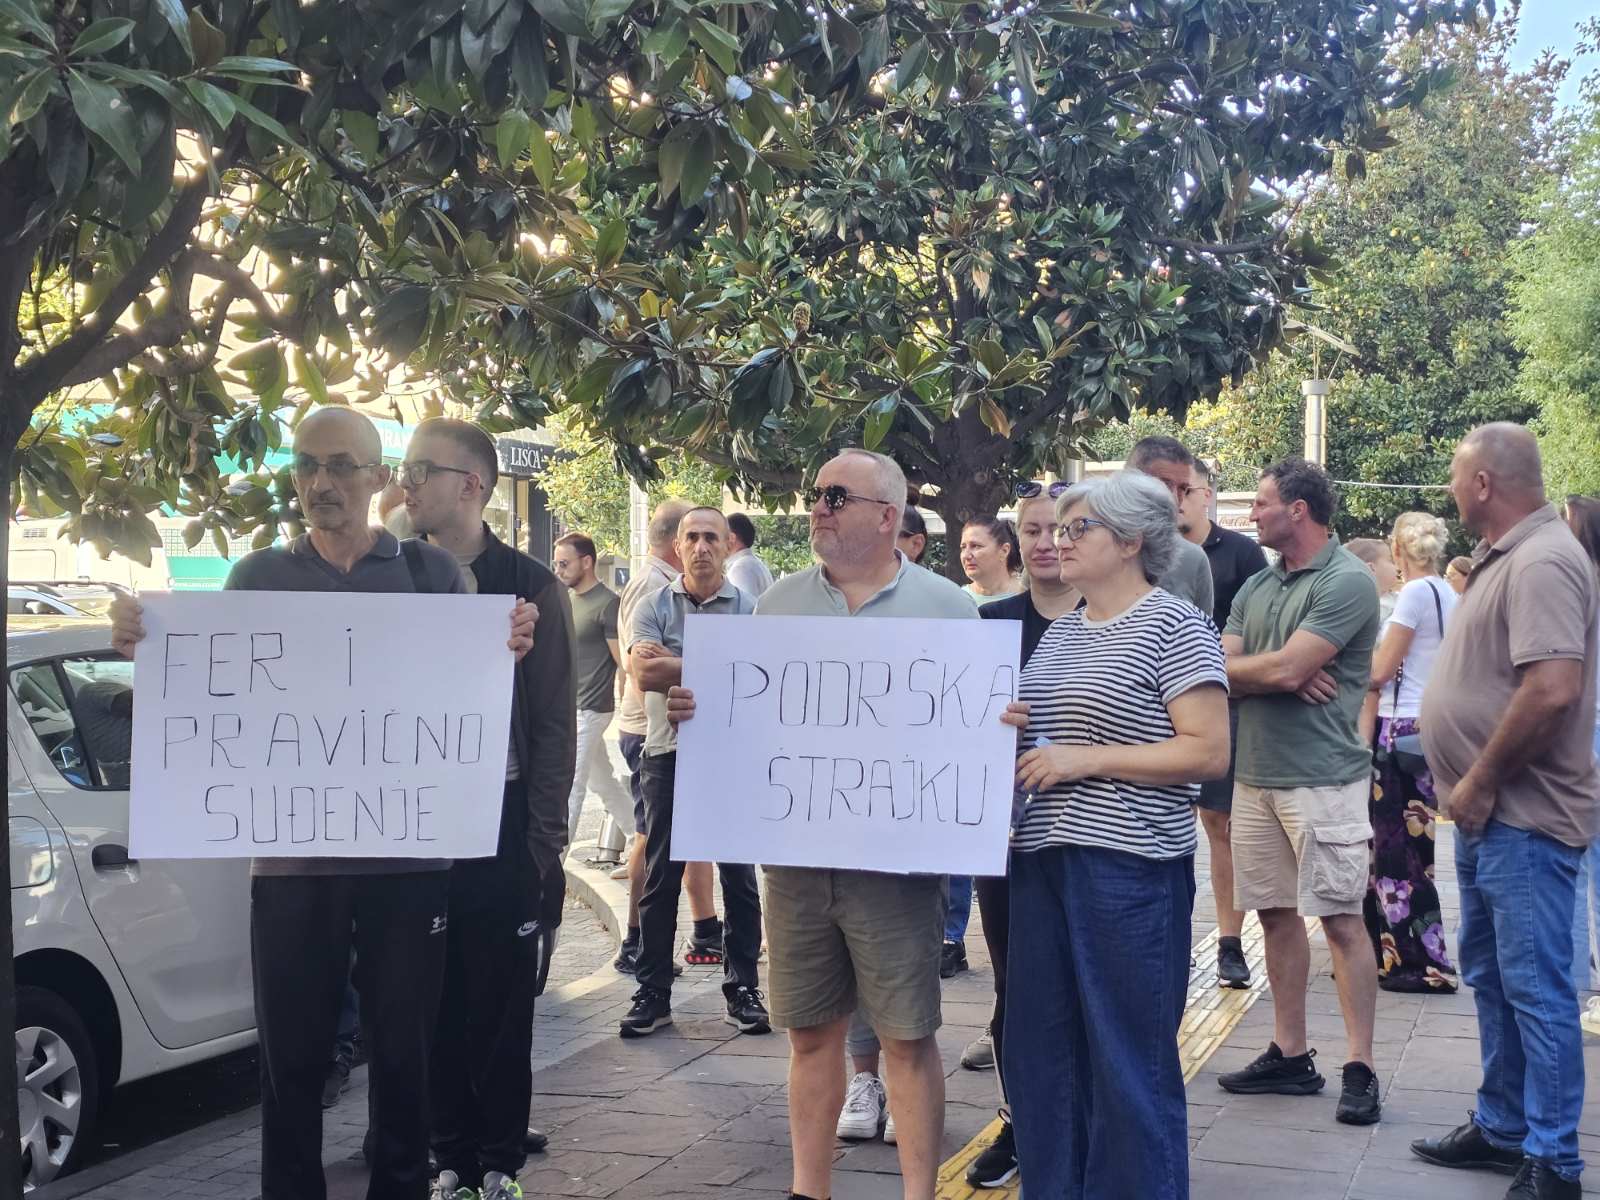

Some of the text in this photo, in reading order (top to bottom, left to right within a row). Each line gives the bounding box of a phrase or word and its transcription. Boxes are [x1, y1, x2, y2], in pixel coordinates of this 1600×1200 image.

[510, 446, 541, 468] LISCA
[162, 631, 288, 699] FER
[726, 648, 1014, 728] PODRŠKA
